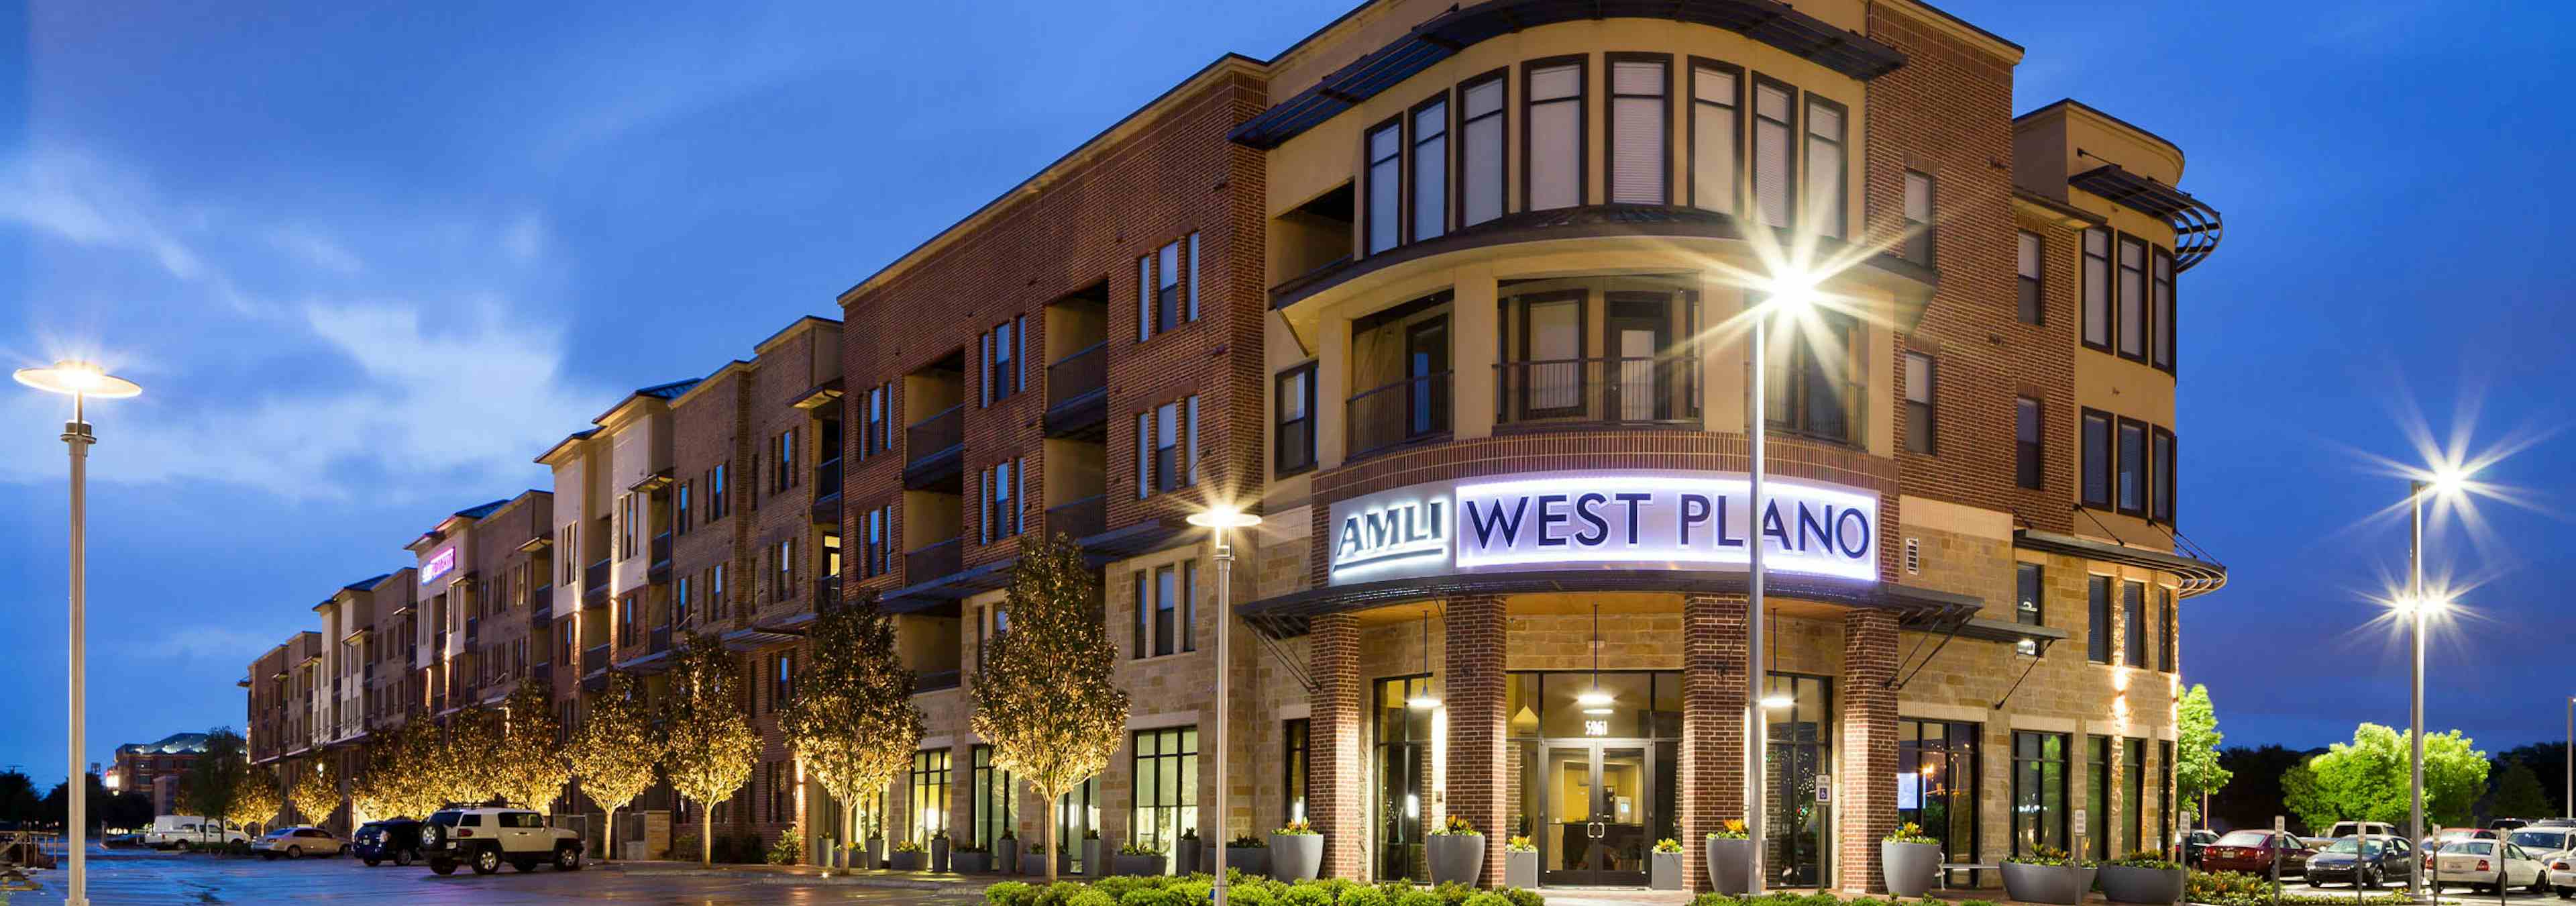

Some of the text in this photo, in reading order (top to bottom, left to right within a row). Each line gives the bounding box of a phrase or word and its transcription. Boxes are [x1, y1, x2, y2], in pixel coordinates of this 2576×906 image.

[1336, 501, 1443, 556] AMLI
[1466, 493, 1870, 559] WEST PLANO
